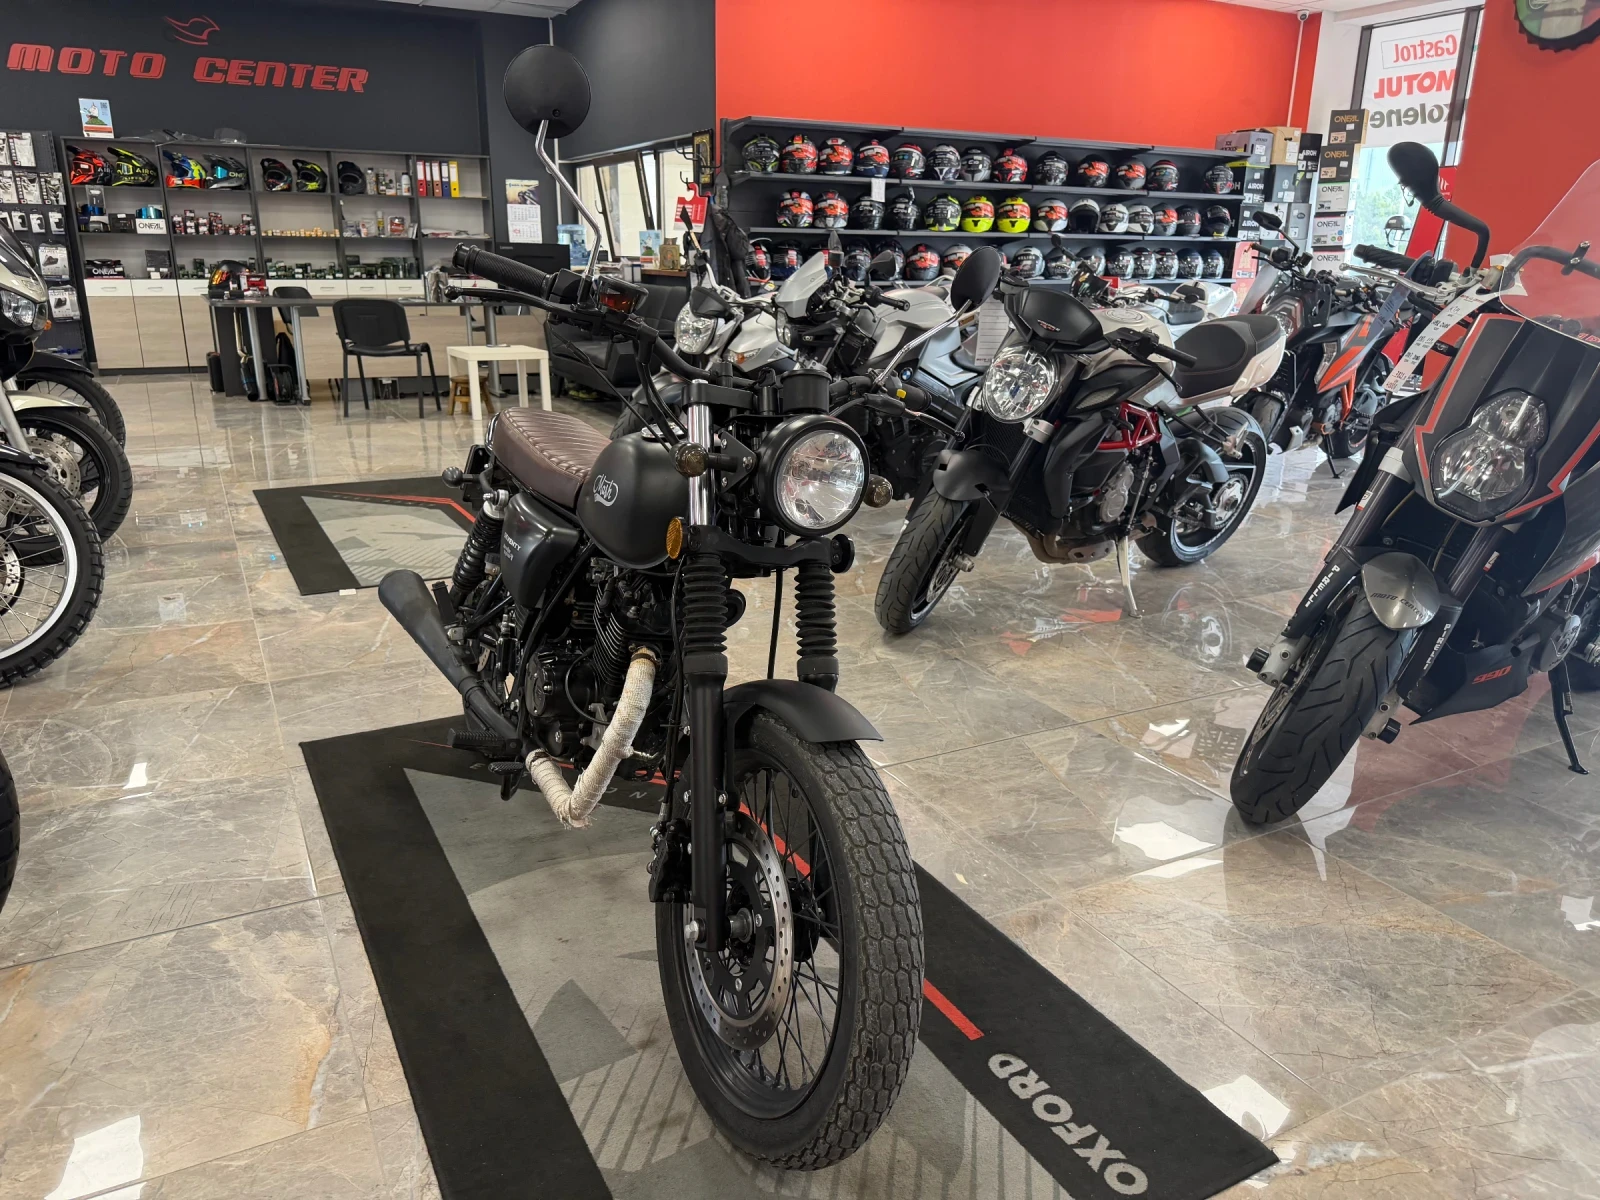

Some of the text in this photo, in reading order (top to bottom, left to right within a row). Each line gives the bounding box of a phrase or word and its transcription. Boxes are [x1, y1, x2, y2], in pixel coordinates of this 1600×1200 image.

[7, 43, 368, 93] MOTO CENTER
[1305, 565, 1340, 607] PIRELLI
[1370, 592, 1398, 600] MOTO
[1423, 623, 1451, 670] PIRELLI
[1472, 665, 1512, 684] 990
[988, 1053, 1148, 1195] OXFORD
